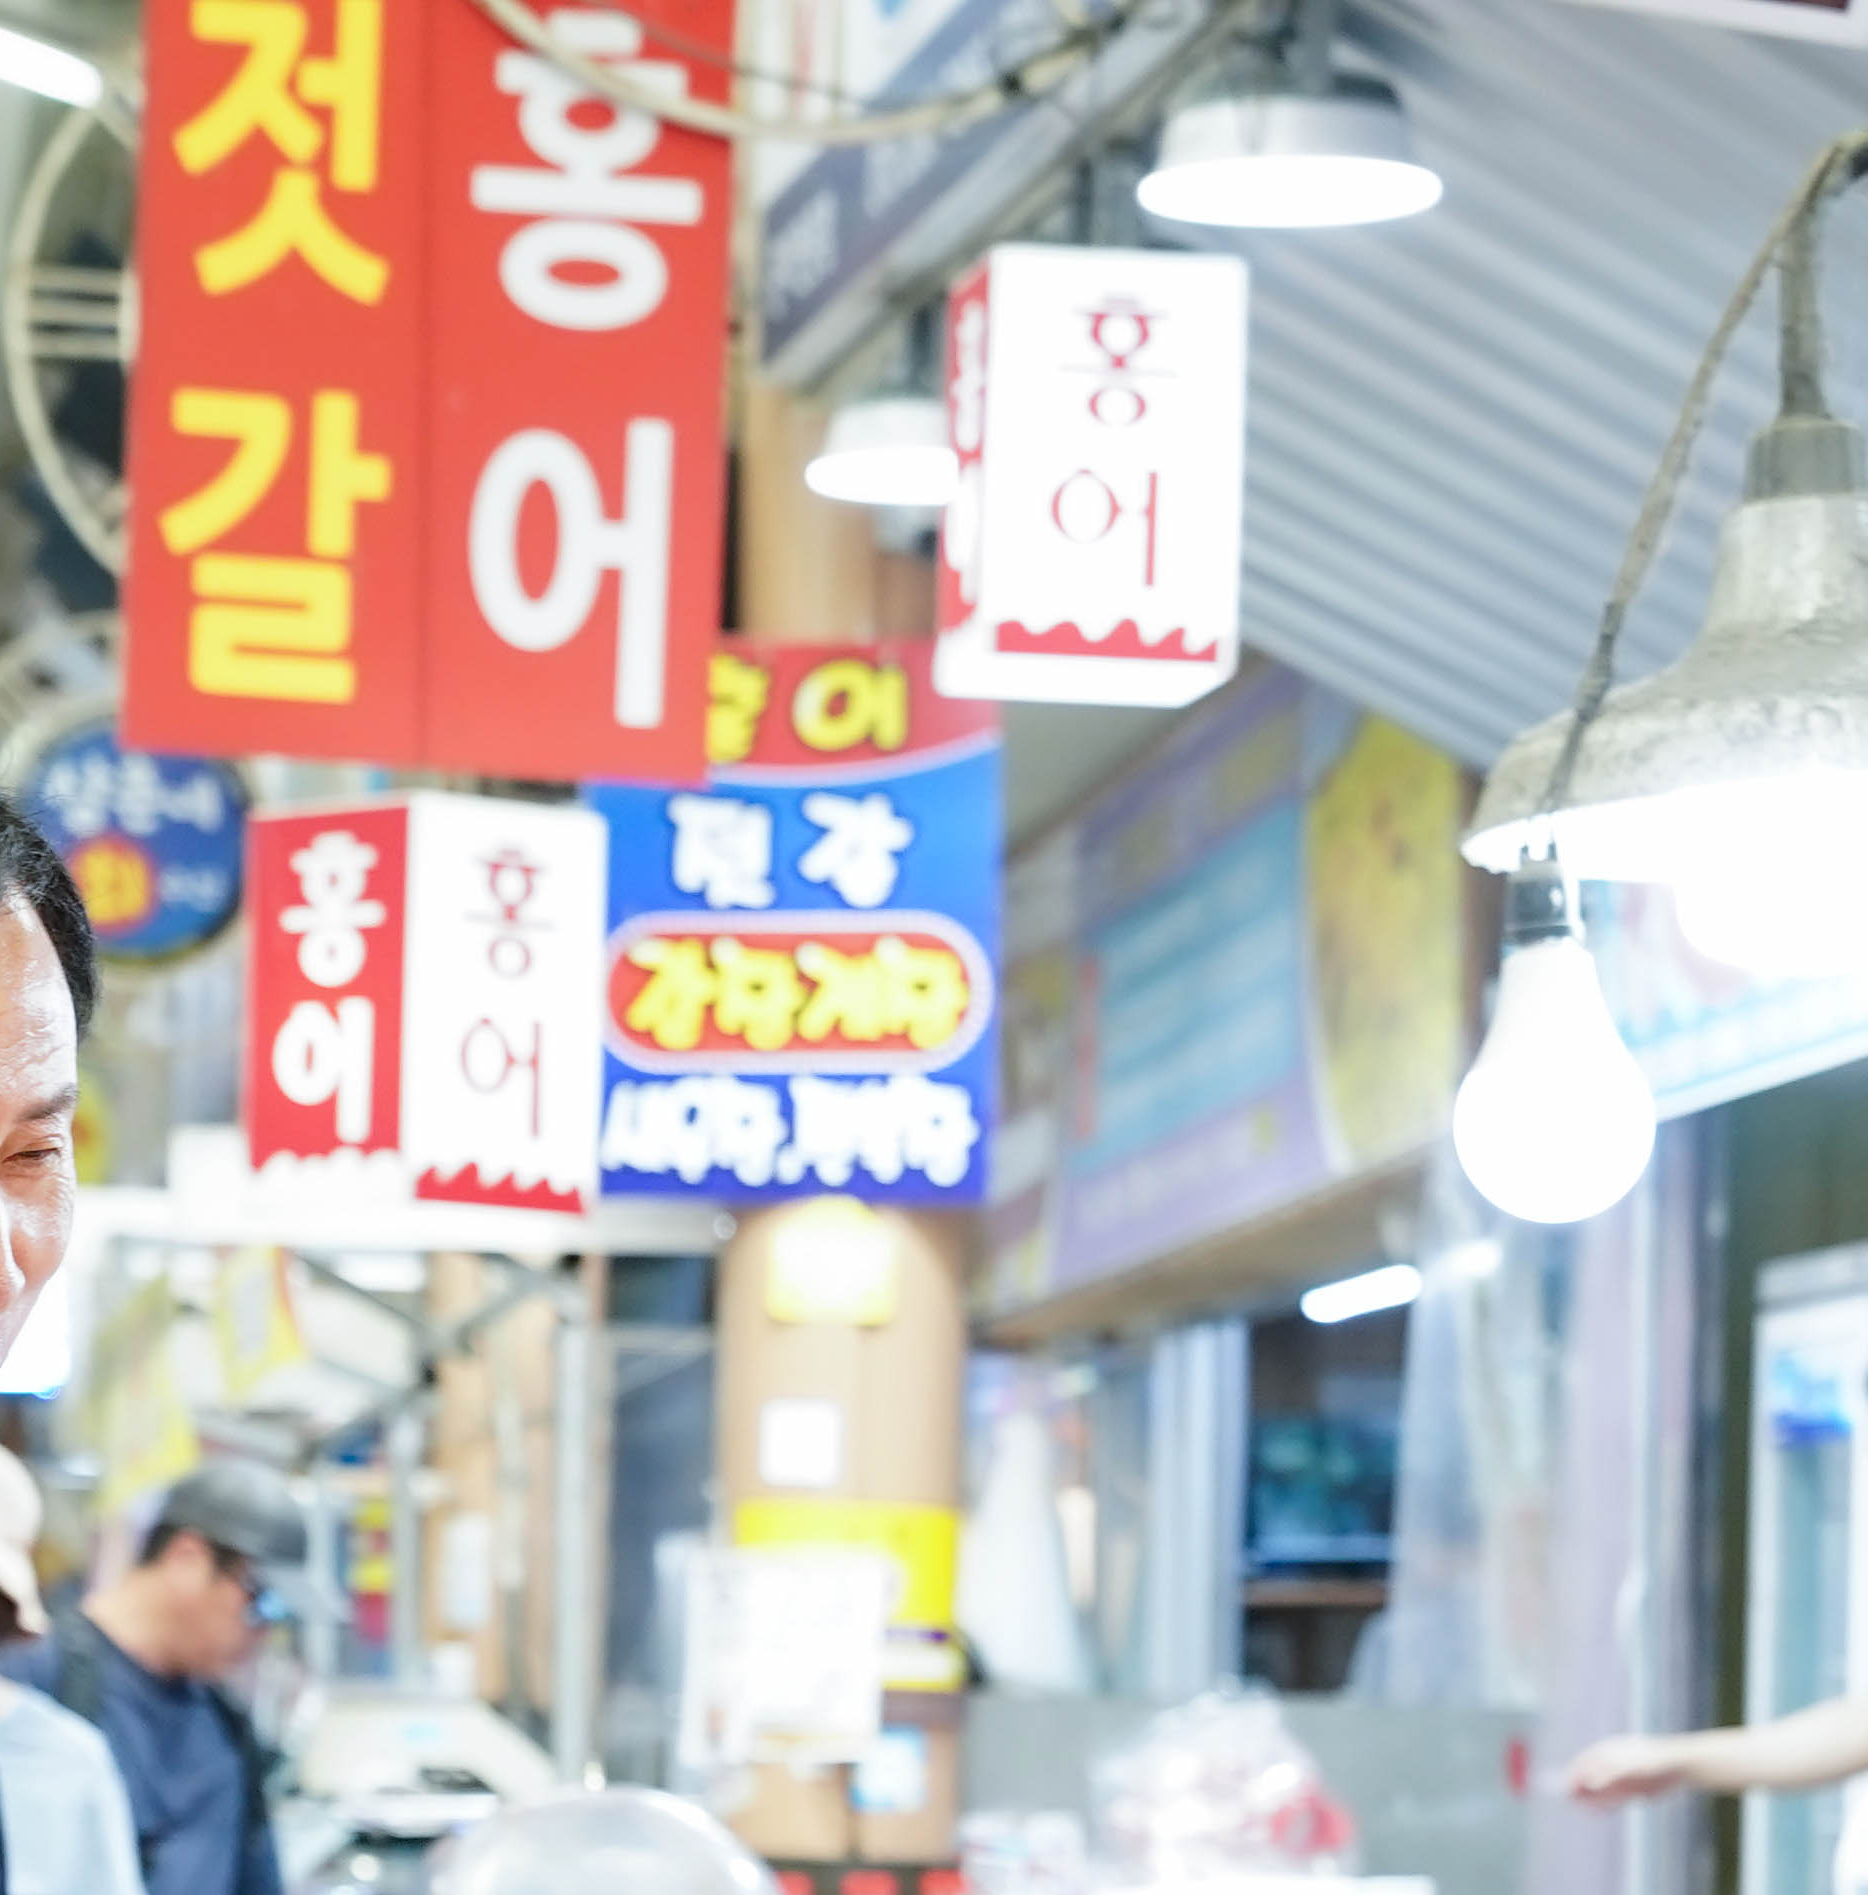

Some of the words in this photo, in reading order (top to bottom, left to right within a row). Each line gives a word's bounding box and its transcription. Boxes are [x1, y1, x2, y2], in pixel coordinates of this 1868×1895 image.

[161, 0, 390, 703] 젓갈
[469, 10, 704, 729] 홍어
[1053, 293, 1177, 588] 홍어
[272, 830, 385, 1144] 홍어
[461, 847, 555, 1140] 홍어
